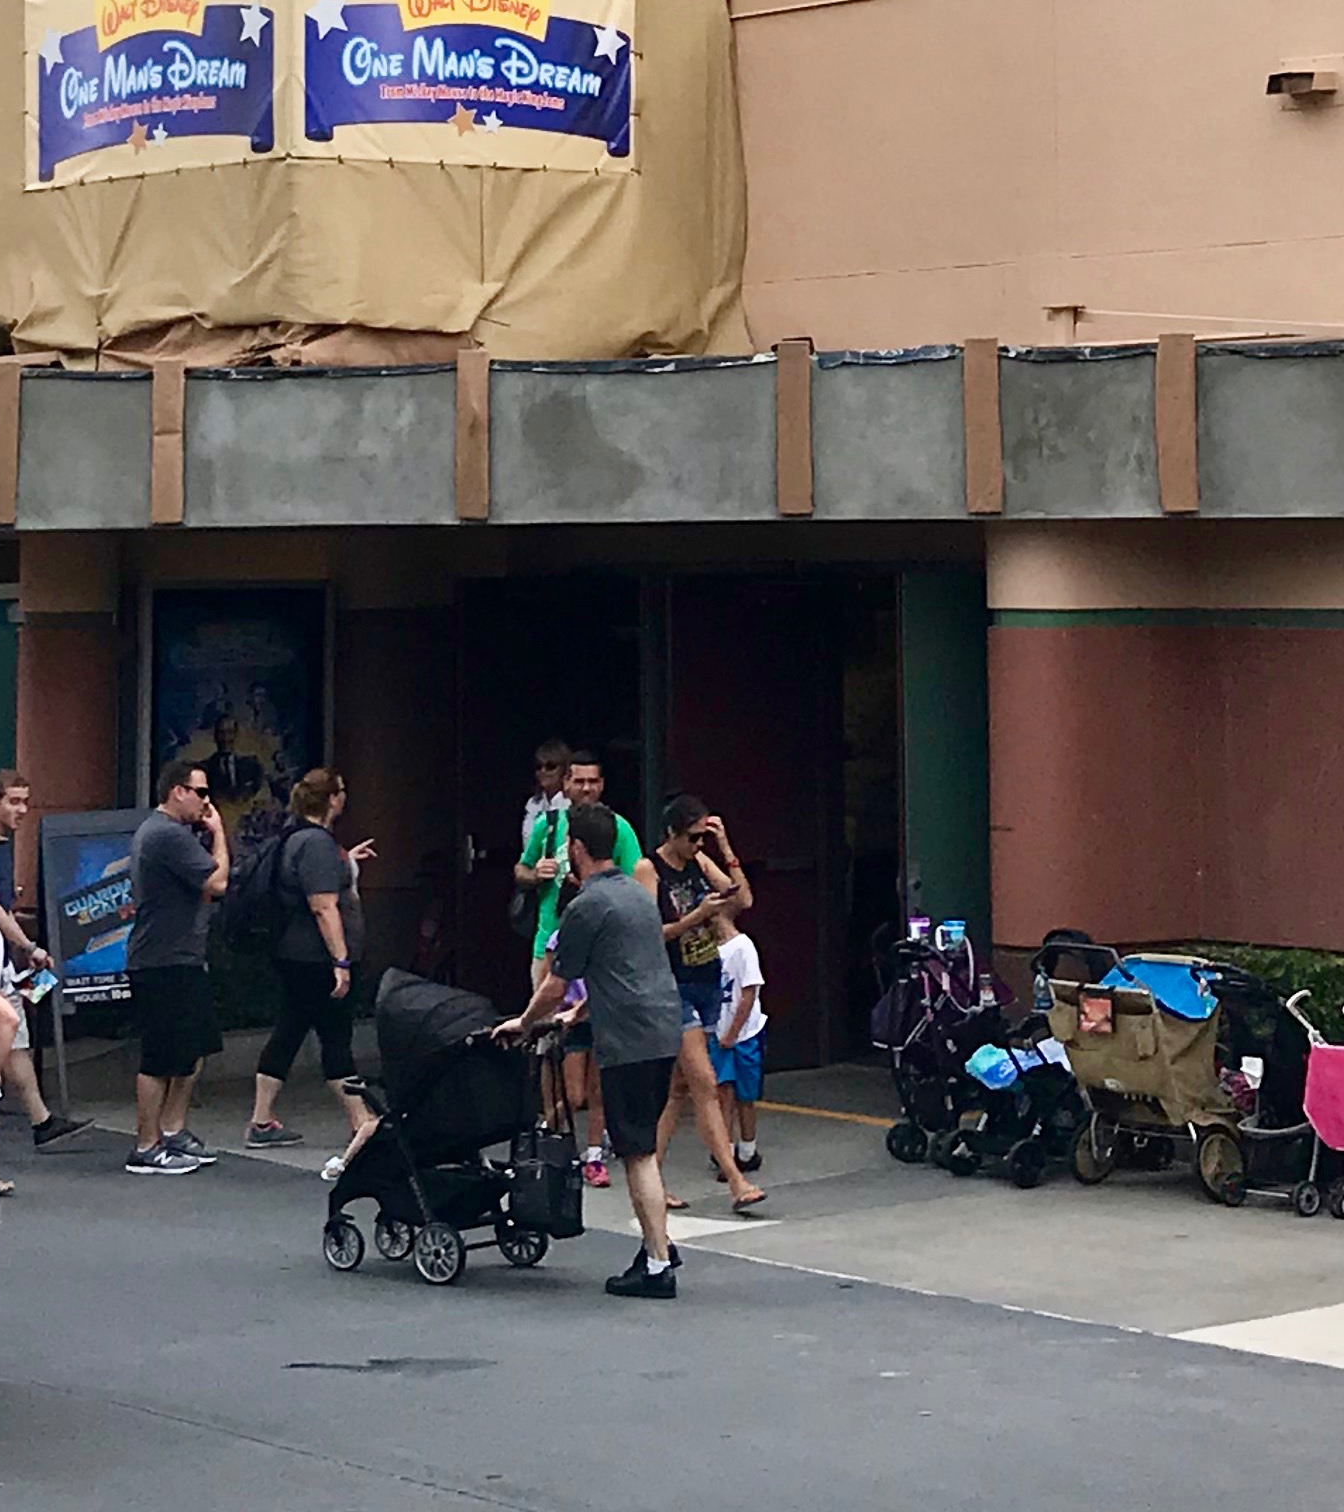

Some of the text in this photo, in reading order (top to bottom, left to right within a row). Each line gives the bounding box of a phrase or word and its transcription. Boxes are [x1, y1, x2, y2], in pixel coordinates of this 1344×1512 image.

[60, 66, 99, 119] ONE
[103, 52, 163, 102] MAN'S
[162, 40, 247, 91] DREAM
[342, 36, 602, 97] ONE MAN'S DREAM
